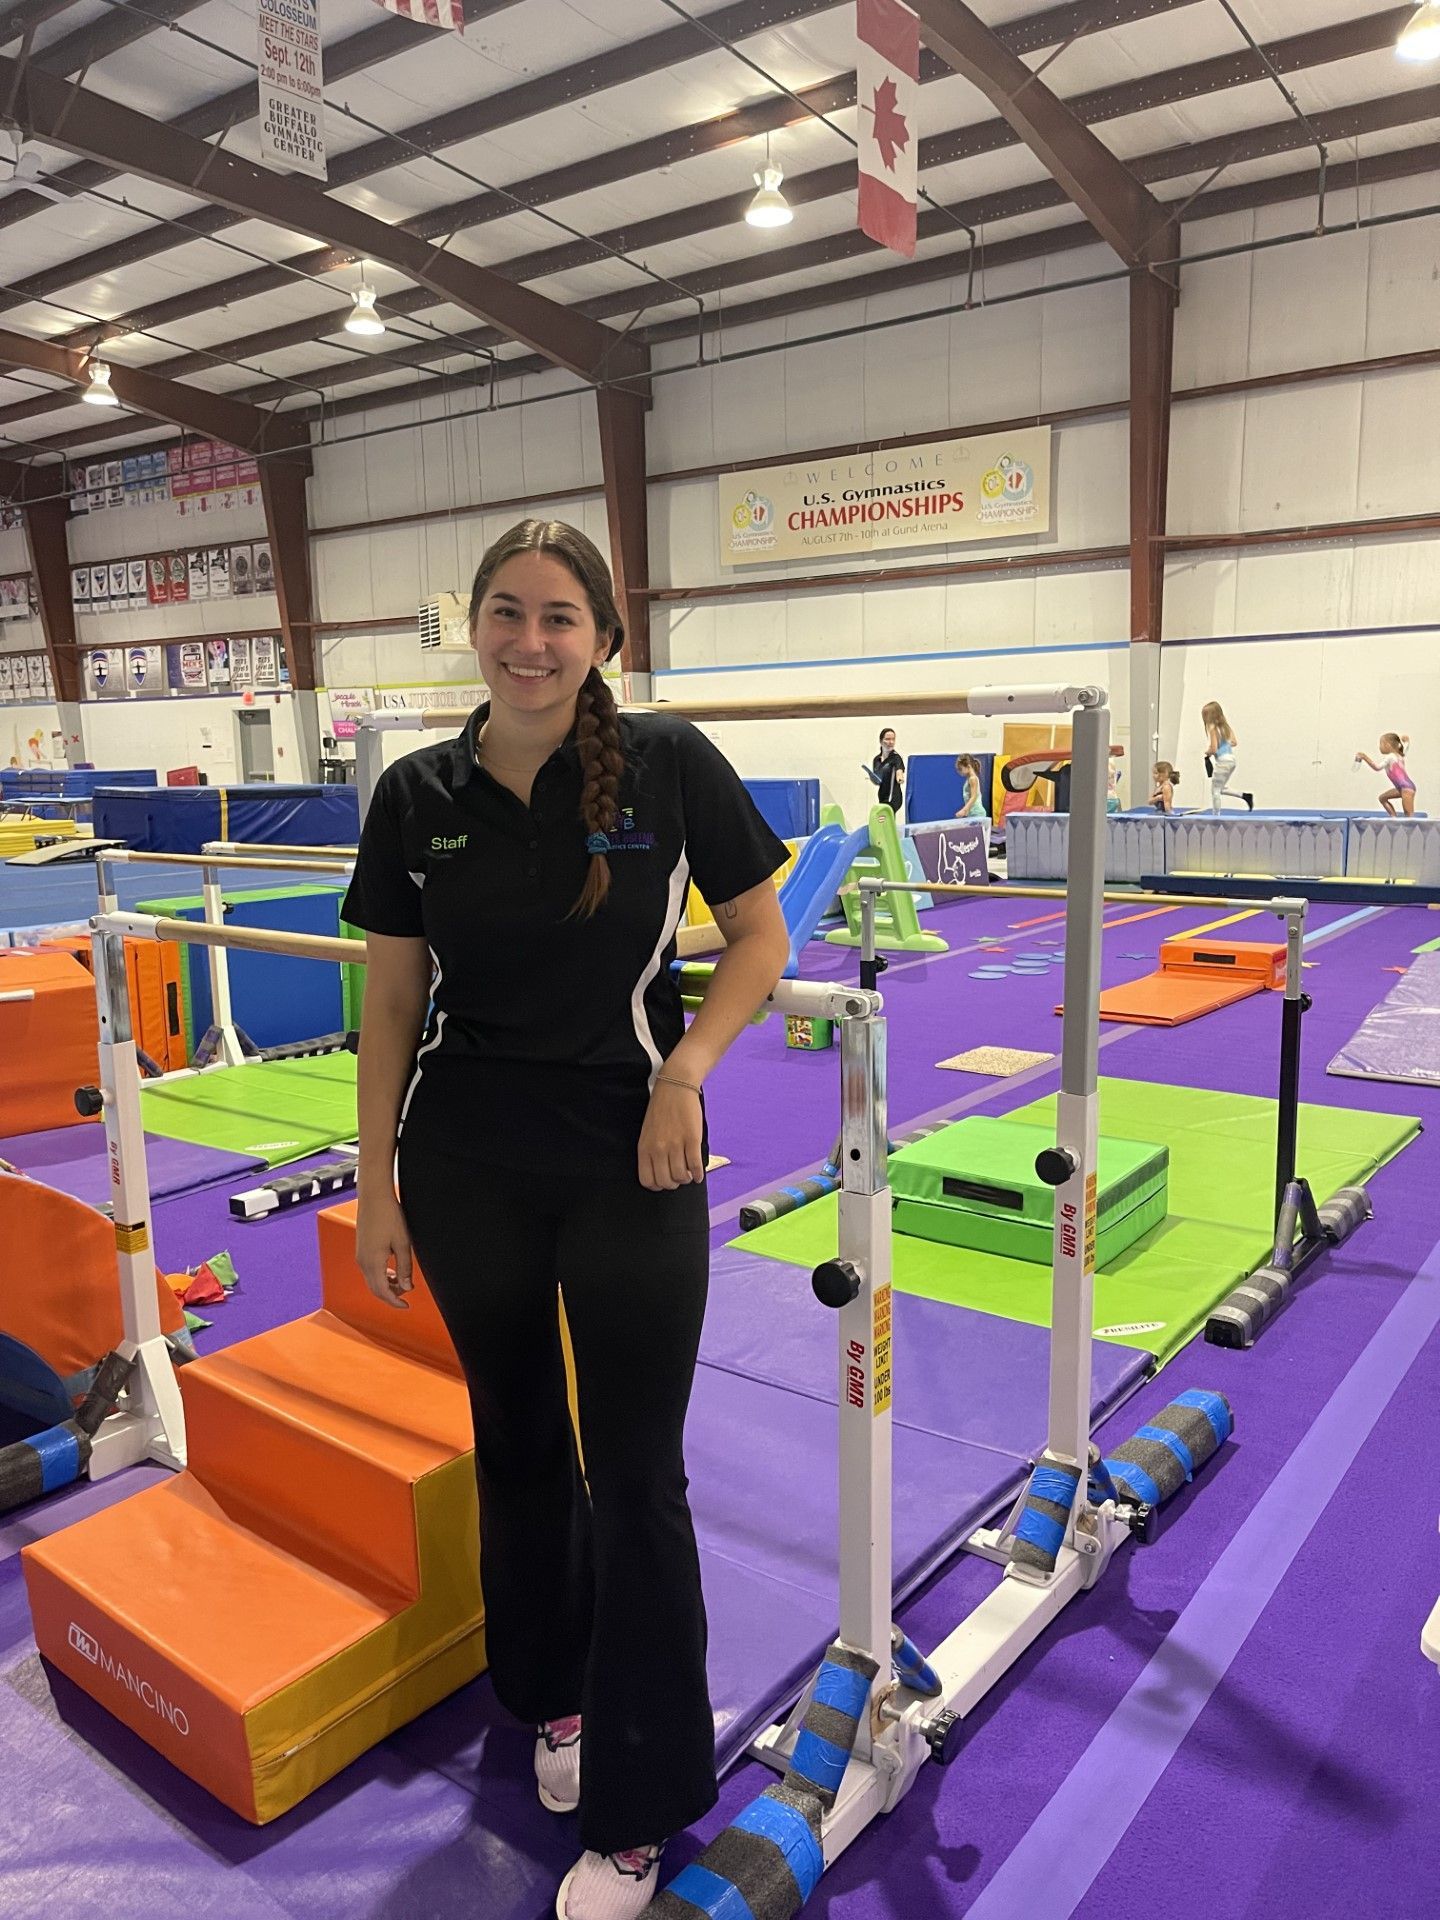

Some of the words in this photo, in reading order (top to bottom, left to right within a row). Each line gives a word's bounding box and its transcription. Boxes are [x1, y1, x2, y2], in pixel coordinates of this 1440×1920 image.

[260, 0, 317, 30] COLOSSEUM
[260, 14, 279, 35] MEET
[281, 23, 295, 42] THE
[296, 29, 319, 51] STARS
[265, 37, 291, 68] Sept.
[294, 50, 316, 77] 12th
[269, 99, 316, 126] GREATER
[270, 110, 317, 138] BUFFALO
[264, 122, 323, 153] GYMNASTIC
[274, 138, 315, 162] CENTER
[804, 492, 835, 506] U.S.
[842, 479, 946, 502] Gymnastics
[788, 492, 964, 531] CHAMPIONSHIPS
[801, 534, 838, 546] AUGUST
[839, 531, 854, 542] 7th
[881, 526, 891, 536] at
[893, 523, 918, 536] Gund
[920, 522, 949, 532] Arena
[382, 694, 406, 709] USA
[409, 691, 458, 709] JUNIOR
[460, 689, 491, 707] OLY
[431, 834, 468, 850] Staff
[1061, 1203, 1077, 1222] By
[1062, 1223, 1077, 1258] GMR
[847, 1339, 865, 1364] By
[874, 1337, 891, 1357] WEIGHT
[875, 1353, 889, 1369] LIMIT
[850, 1364, 865, 1409] GMR
[874, 1369, 891, 1390] UNDER
[100, 1648, 190, 1736] MANCINO
